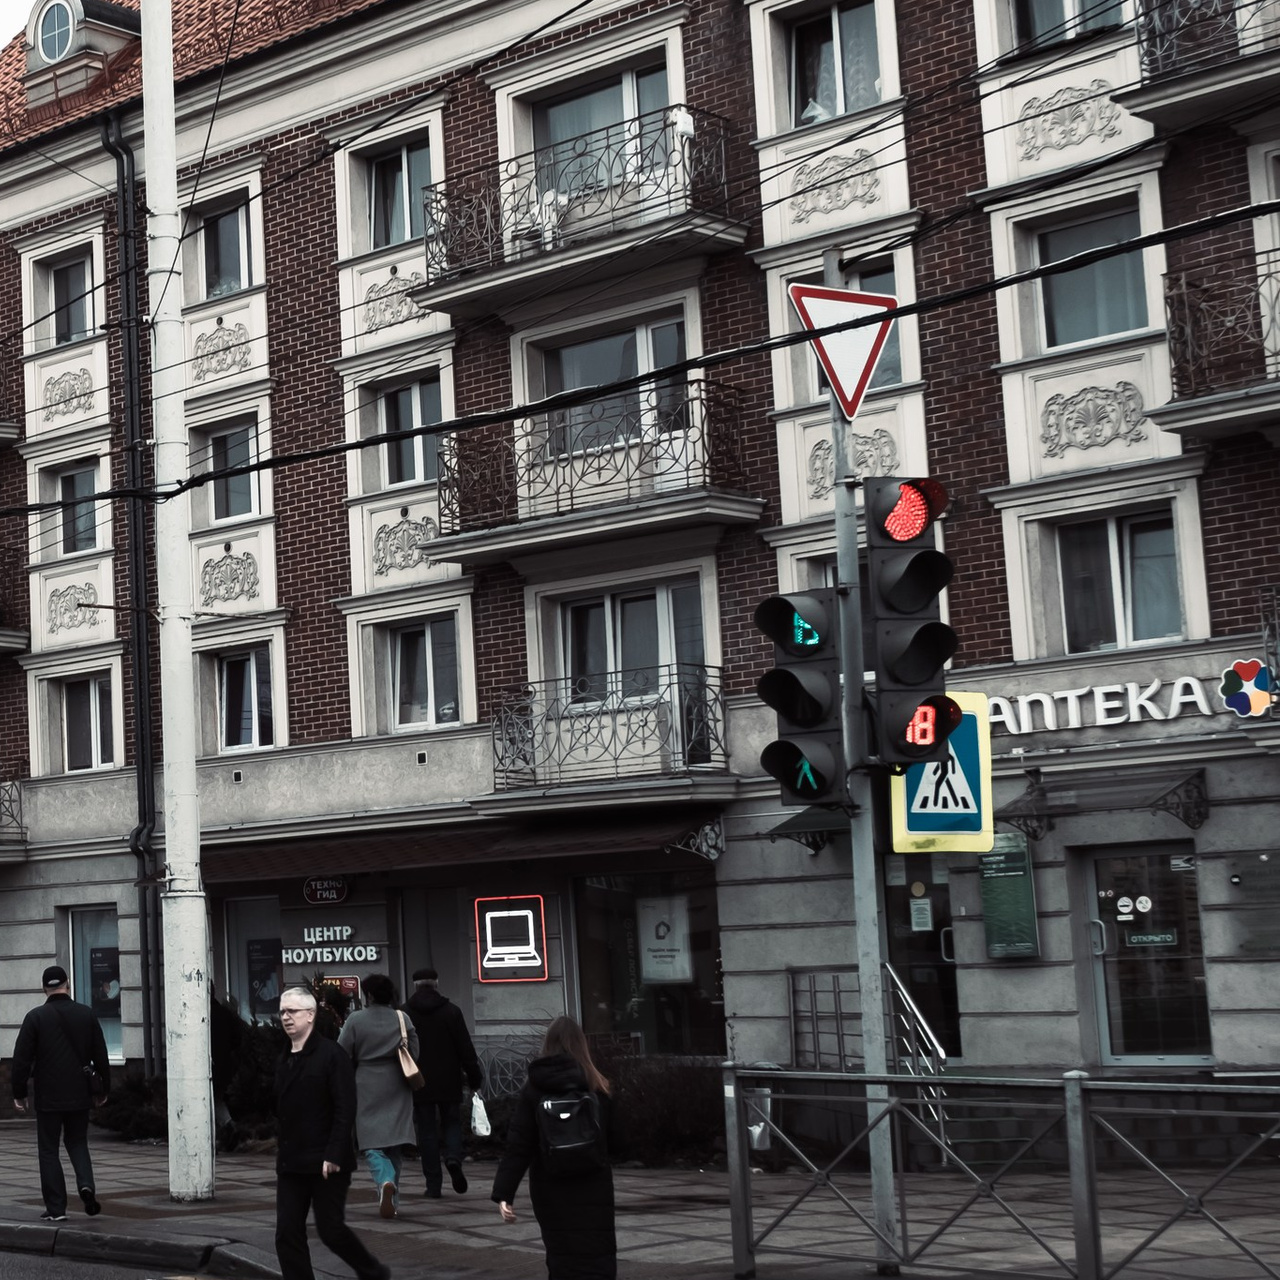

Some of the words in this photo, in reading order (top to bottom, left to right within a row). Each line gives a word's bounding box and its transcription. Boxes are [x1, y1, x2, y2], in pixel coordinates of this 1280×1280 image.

[988, 676, 1213, 735] АПТЕКА
[310, 879, 343, 890] ТЕХНО
[316, 889, 337, 900] ГИД
[303, 925, 352, 945] ЦЕНТР
[281, 945, 379, 964] НОУТБУКОВ
